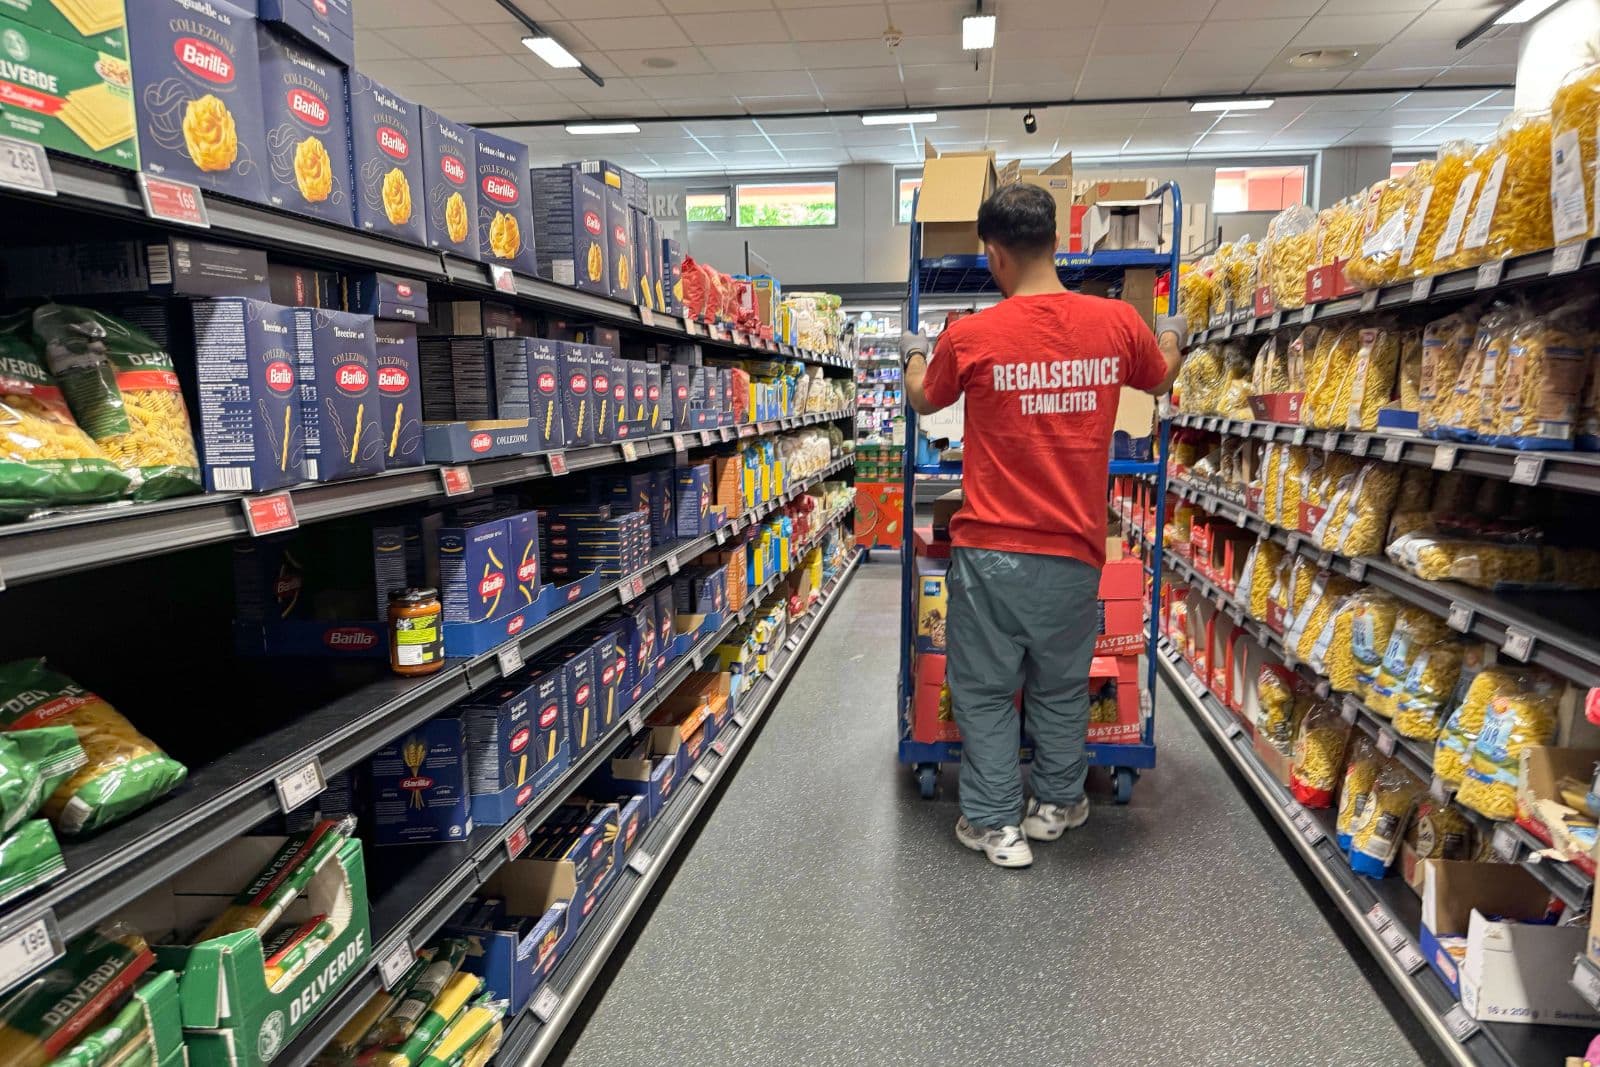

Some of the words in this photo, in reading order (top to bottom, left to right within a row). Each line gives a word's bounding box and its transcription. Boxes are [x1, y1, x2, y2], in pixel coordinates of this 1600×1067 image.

[169, 18, 237, 57] COLLEZIONE
[183, 43, 229, 78] Barilla
[293, 94, 325, 121] Barilla
[381, 131, 406, 154] Barilla
[444, 161, 464, 179] Barilla
[176, 191, 196, 210] 169
[487, 179, 515, 199] Barilla
[270, 368, 292, 384] Barilla
[340, 370, 367, 385] Barilla
[378, 375, 408, 387] Barilla
[993, 357, 1120, 391] REGALSERVICE
[1019, 391, 1097, 416] TEAMLEITER
[330, 632, 375, 645] Barilla
[1087, 723, 1140, 737] BAYERN
[403, 779, 431, 788] Barilla
[250, 838, 304, 896] DELVERDE
[21, 928, 45, 955] 199
[42, 957, 124, 1025] DELVERDE
[290, 933, 364, 1026] DELVERDE
